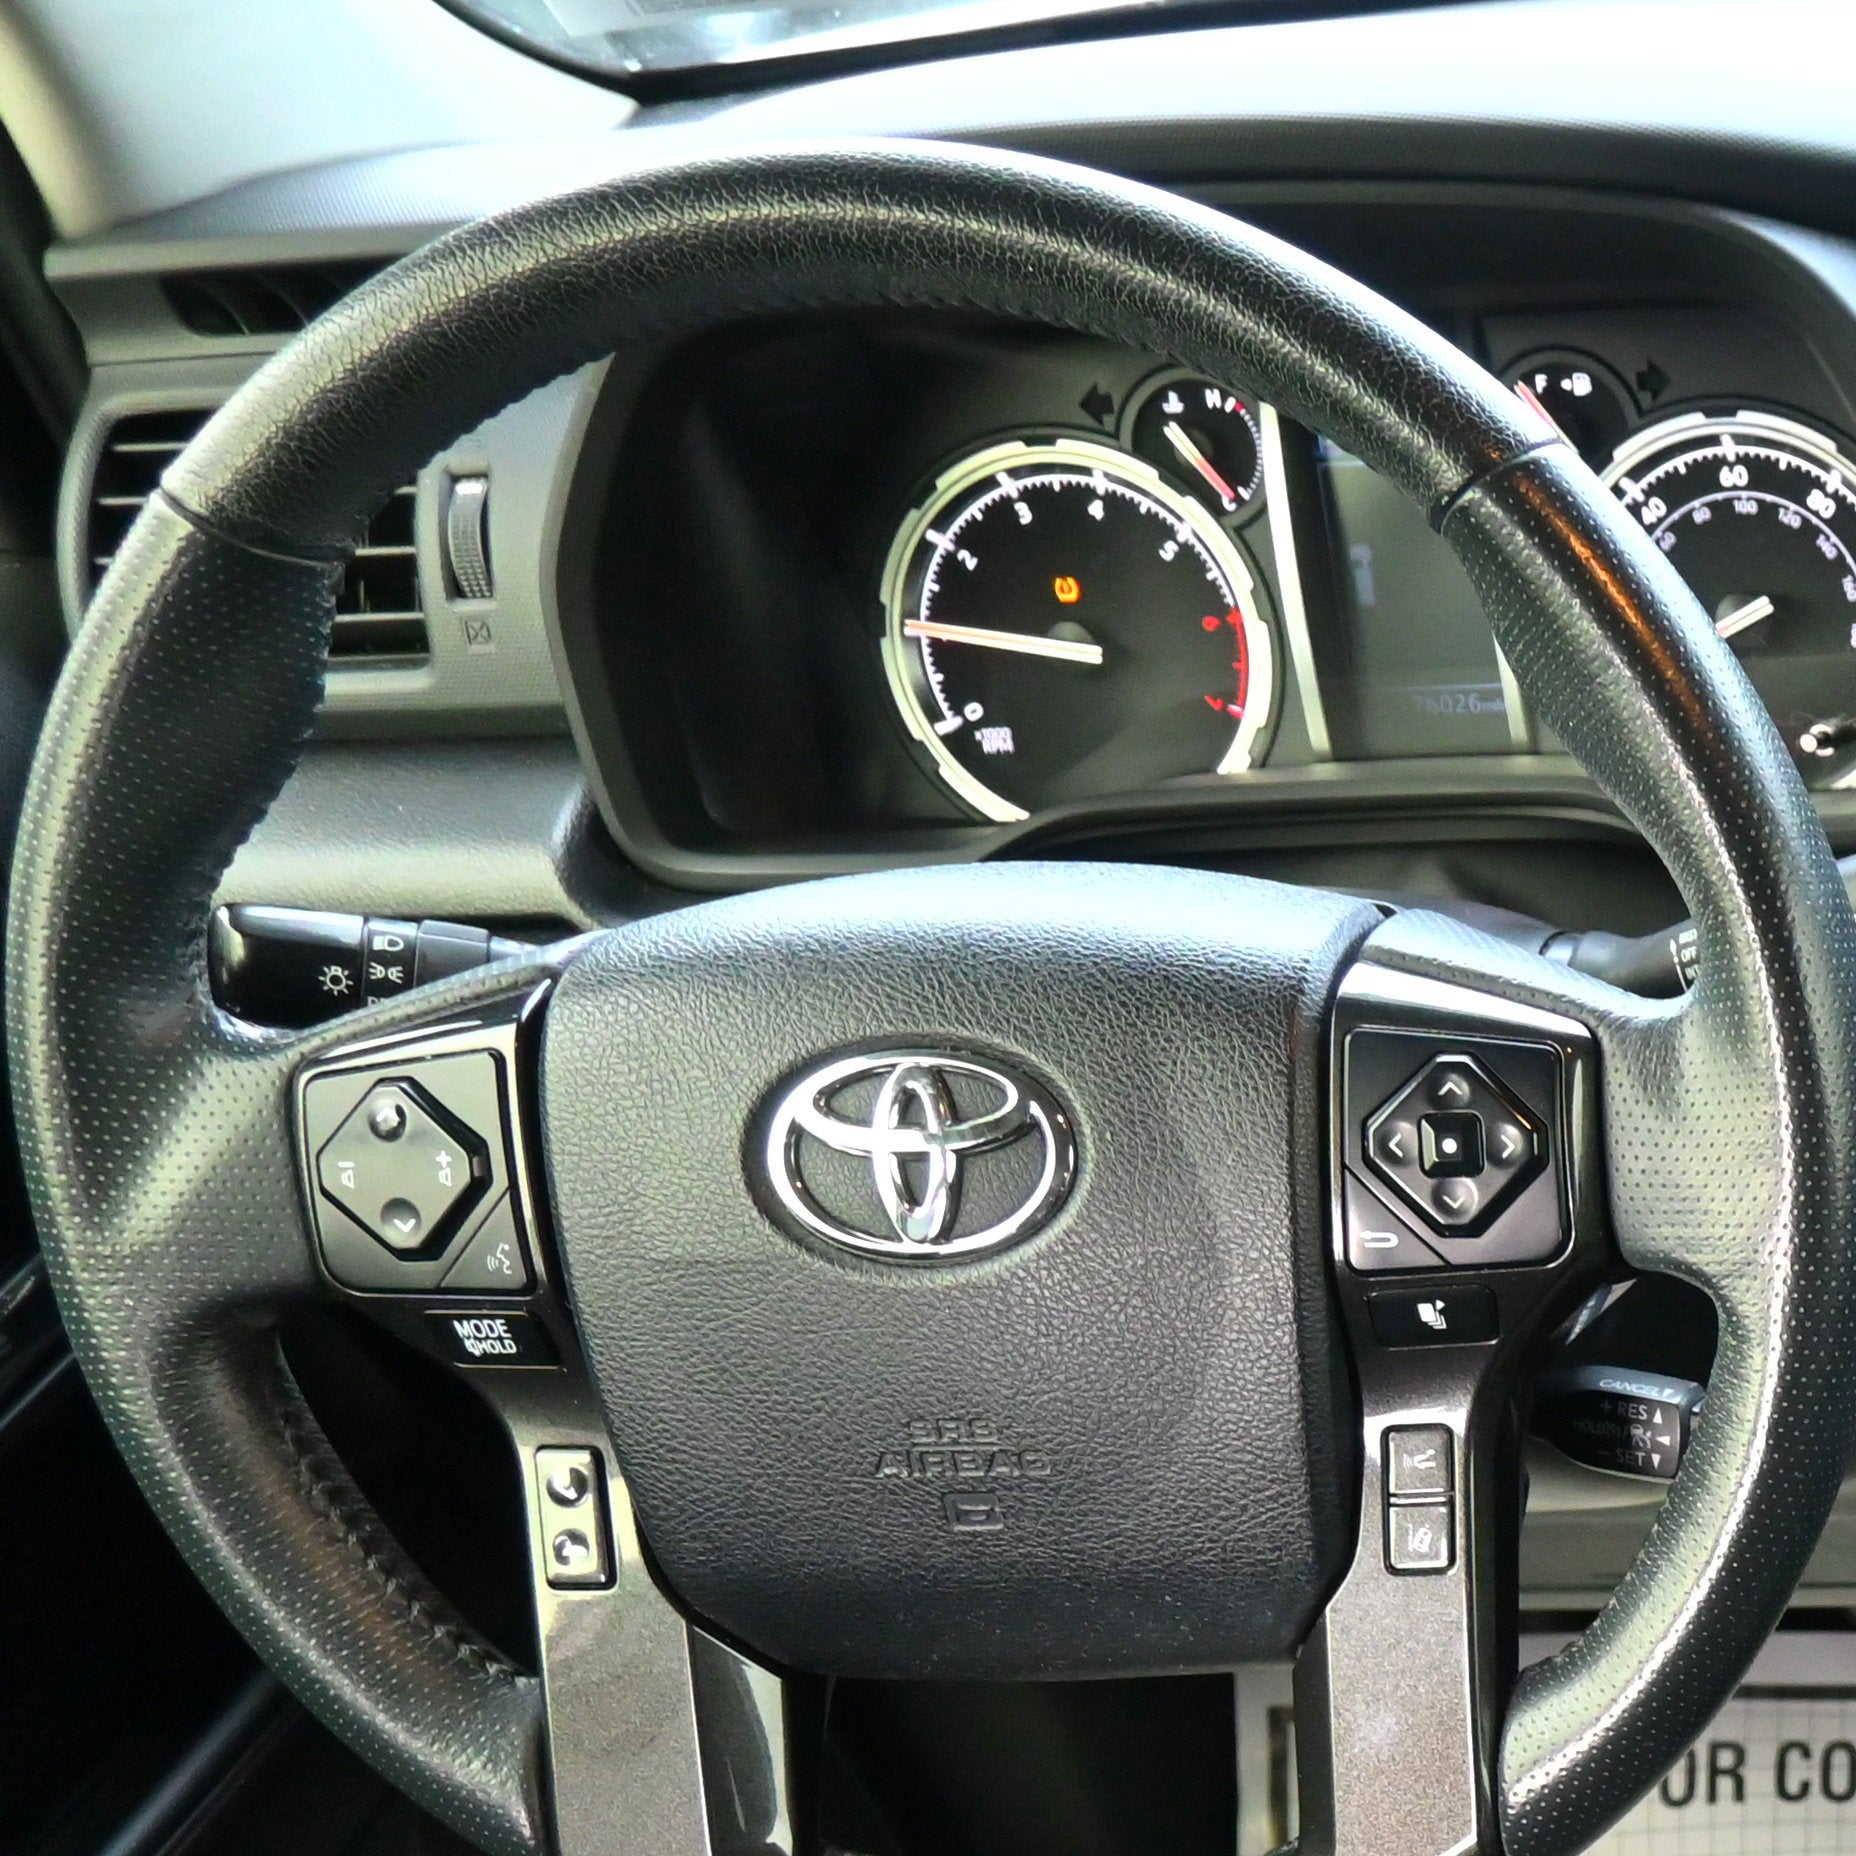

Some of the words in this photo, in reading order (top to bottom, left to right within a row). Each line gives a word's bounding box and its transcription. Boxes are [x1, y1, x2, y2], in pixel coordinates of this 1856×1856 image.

[1535, 373, 1548, 394] F
[1719, 465, 1749, 488] 60
[1013, 501, 1033, 526] 3
[1087, 499, 1105, 521] 4
[1640, 495, 1668, 526] 40
[1733, 500, 1758, 516] 100
[1806, 489, 1837, 519] 80
[1778, 507, 1802, 529] 120
[957, 548, 979, 572] 2
[1158, 540, 1180, 562] 5
[964, 702, 984, 722] 0
[453, 1319, 512, 1339] MODE
[480, 1339, 517, 1354] HOLD
[1600, 1379, 1660, 1397] CANCEL
[1617, 1404, 1648, 1420] RES
[1616, 1449, 1646, 1467] SET
[1657, 1740, 1746, 1809] OR
